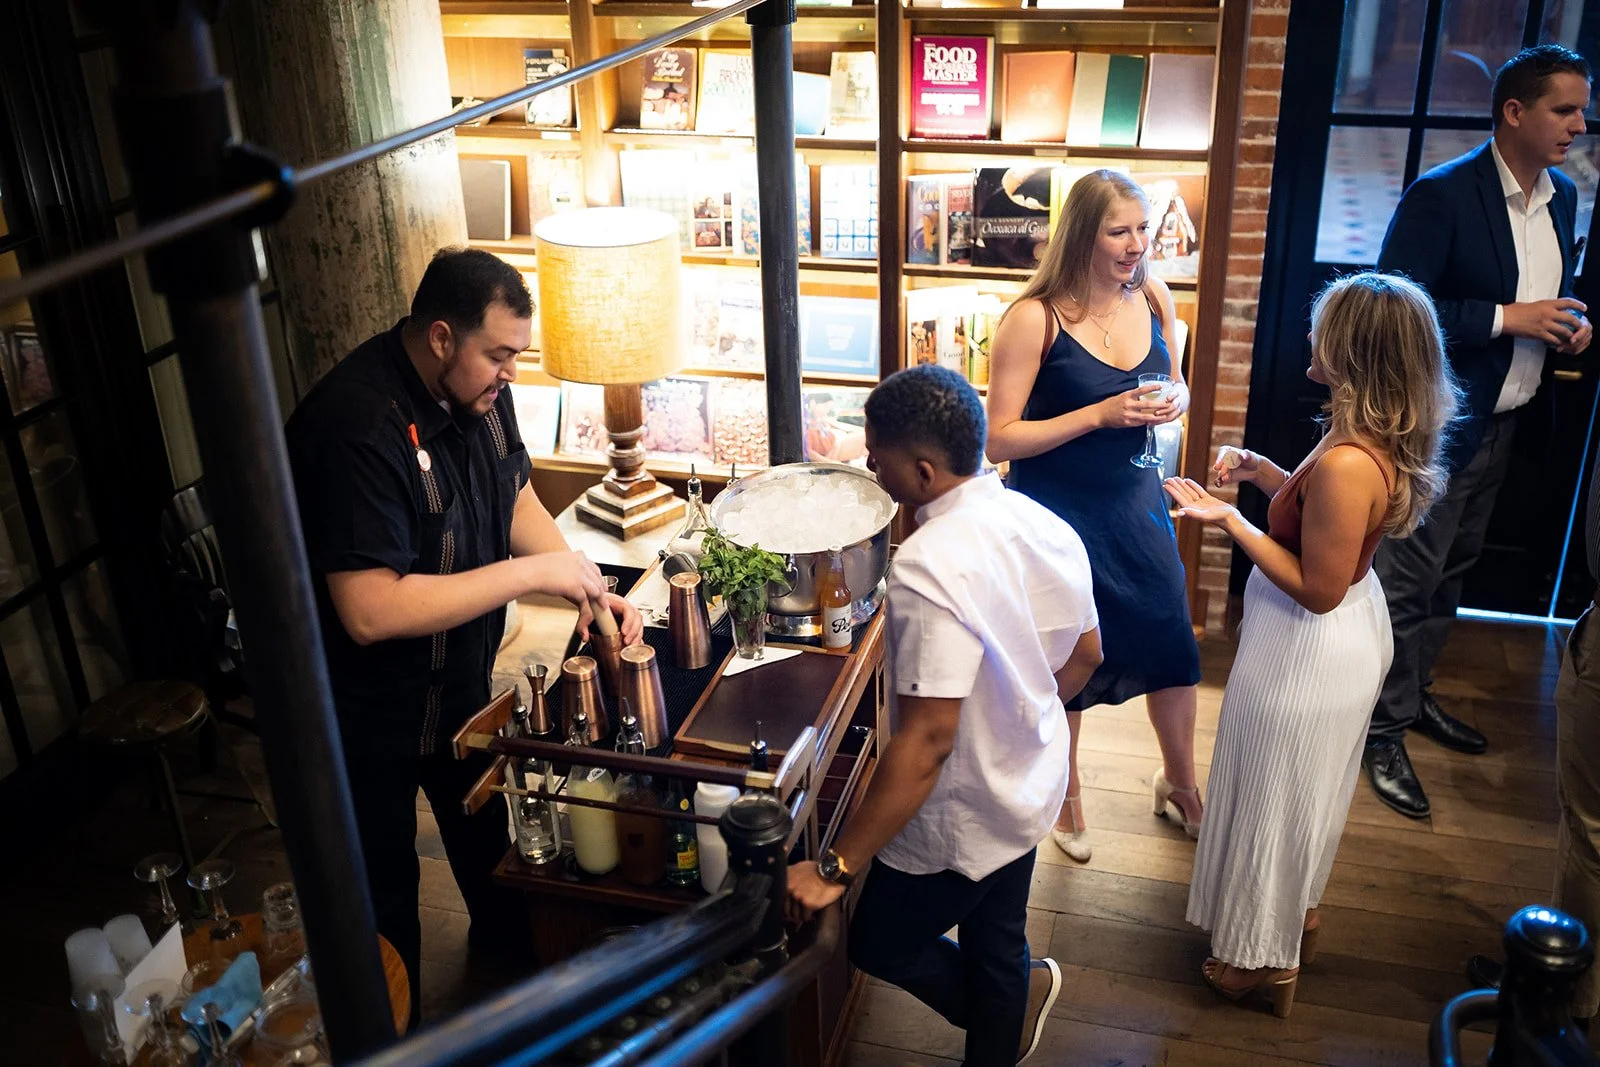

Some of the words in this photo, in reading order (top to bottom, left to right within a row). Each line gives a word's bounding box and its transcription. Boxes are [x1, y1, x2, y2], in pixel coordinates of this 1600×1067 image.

[924, 46, 977, 64] FOOD
[923, 69, 978, 82] MASTER
[982, 221, 1017, 234] Oaxaca
